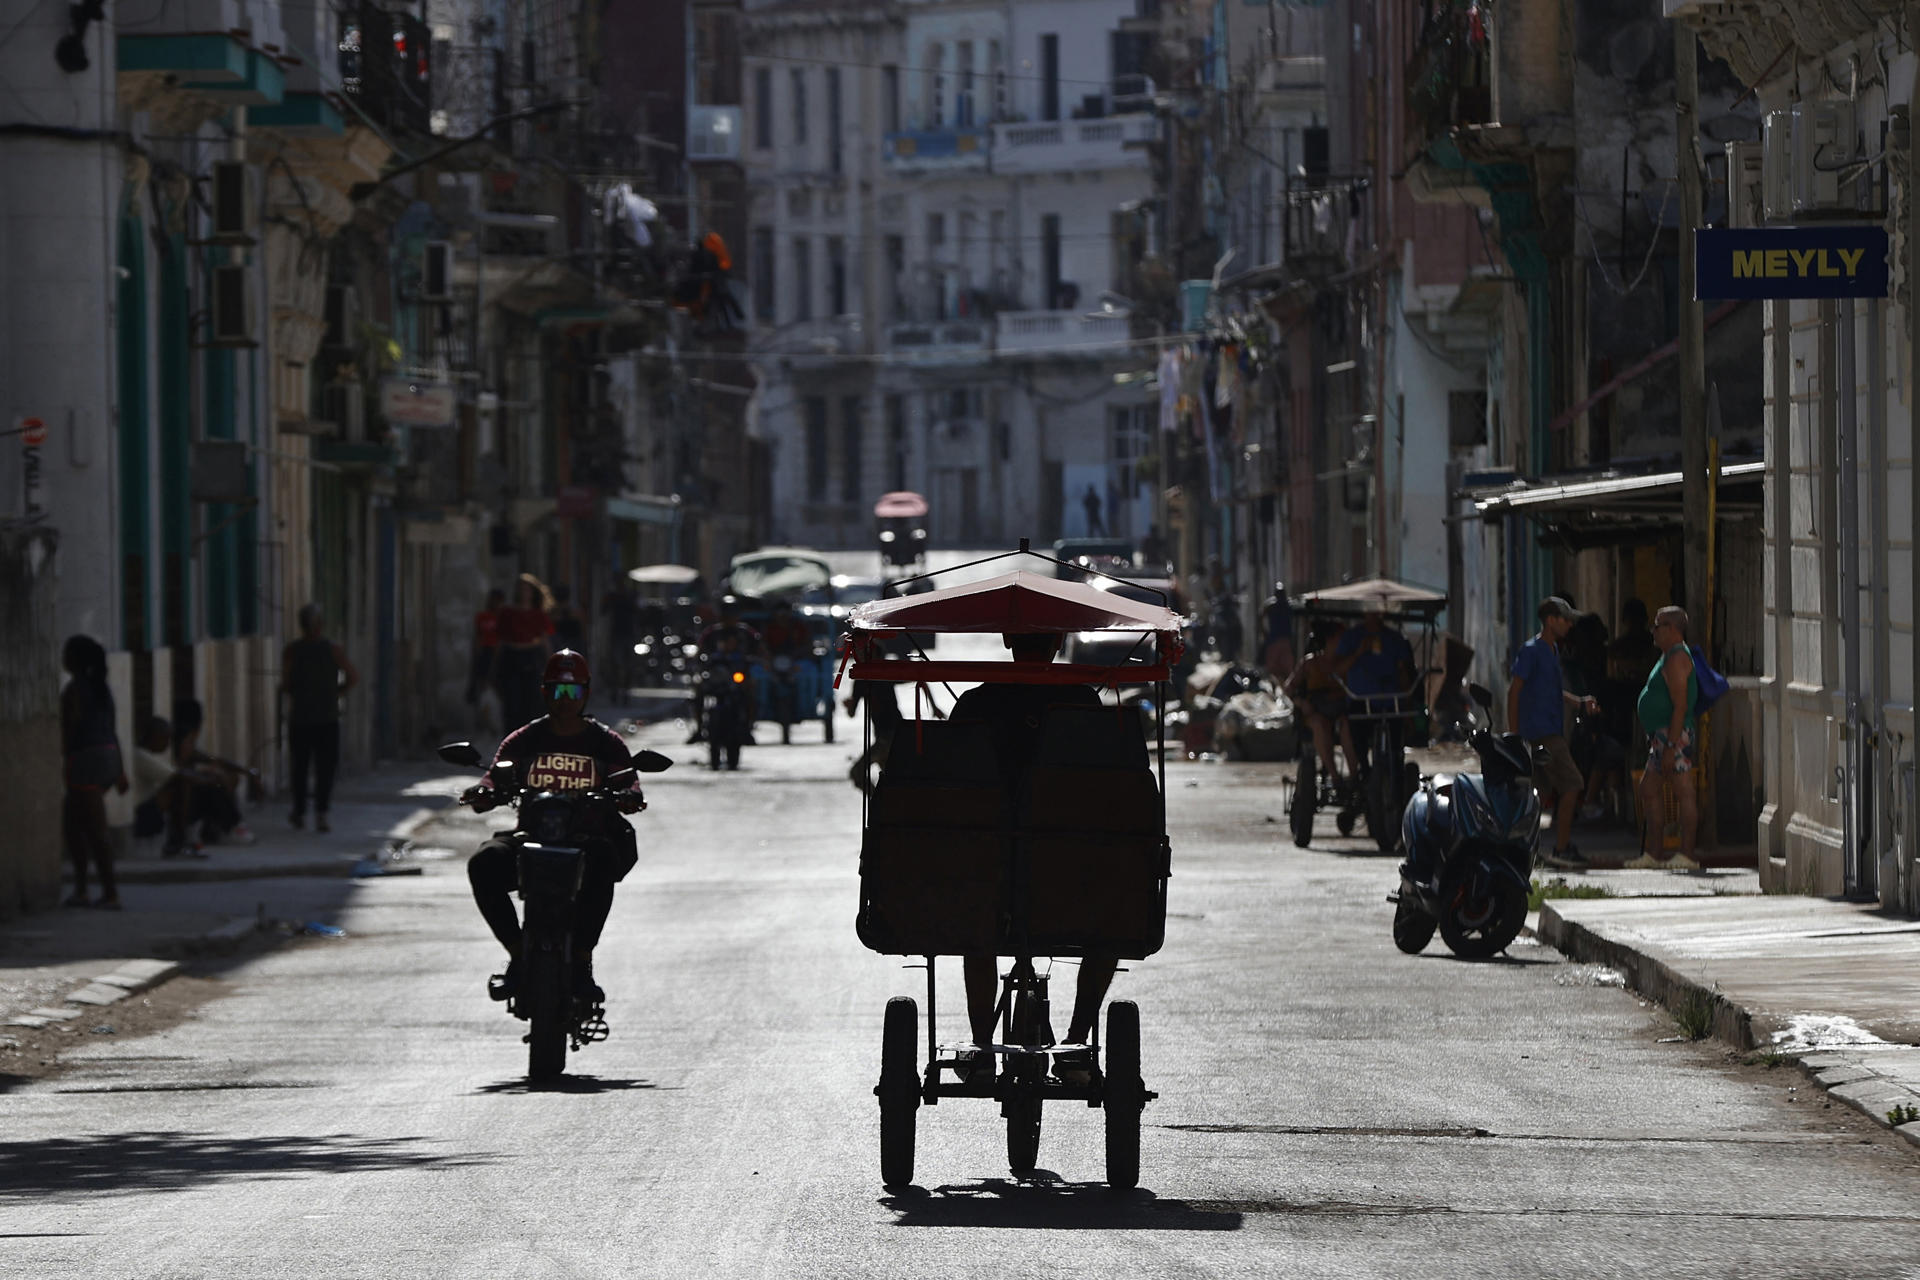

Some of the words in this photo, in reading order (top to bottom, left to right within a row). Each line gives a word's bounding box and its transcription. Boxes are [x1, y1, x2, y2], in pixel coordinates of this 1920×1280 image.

[1732, 248, 1865, 278] MEYLY
[536, 756, 587, 772] LIGHT
[530, 774, 554, 788] UP
[557, 775, 591, 789] THE
